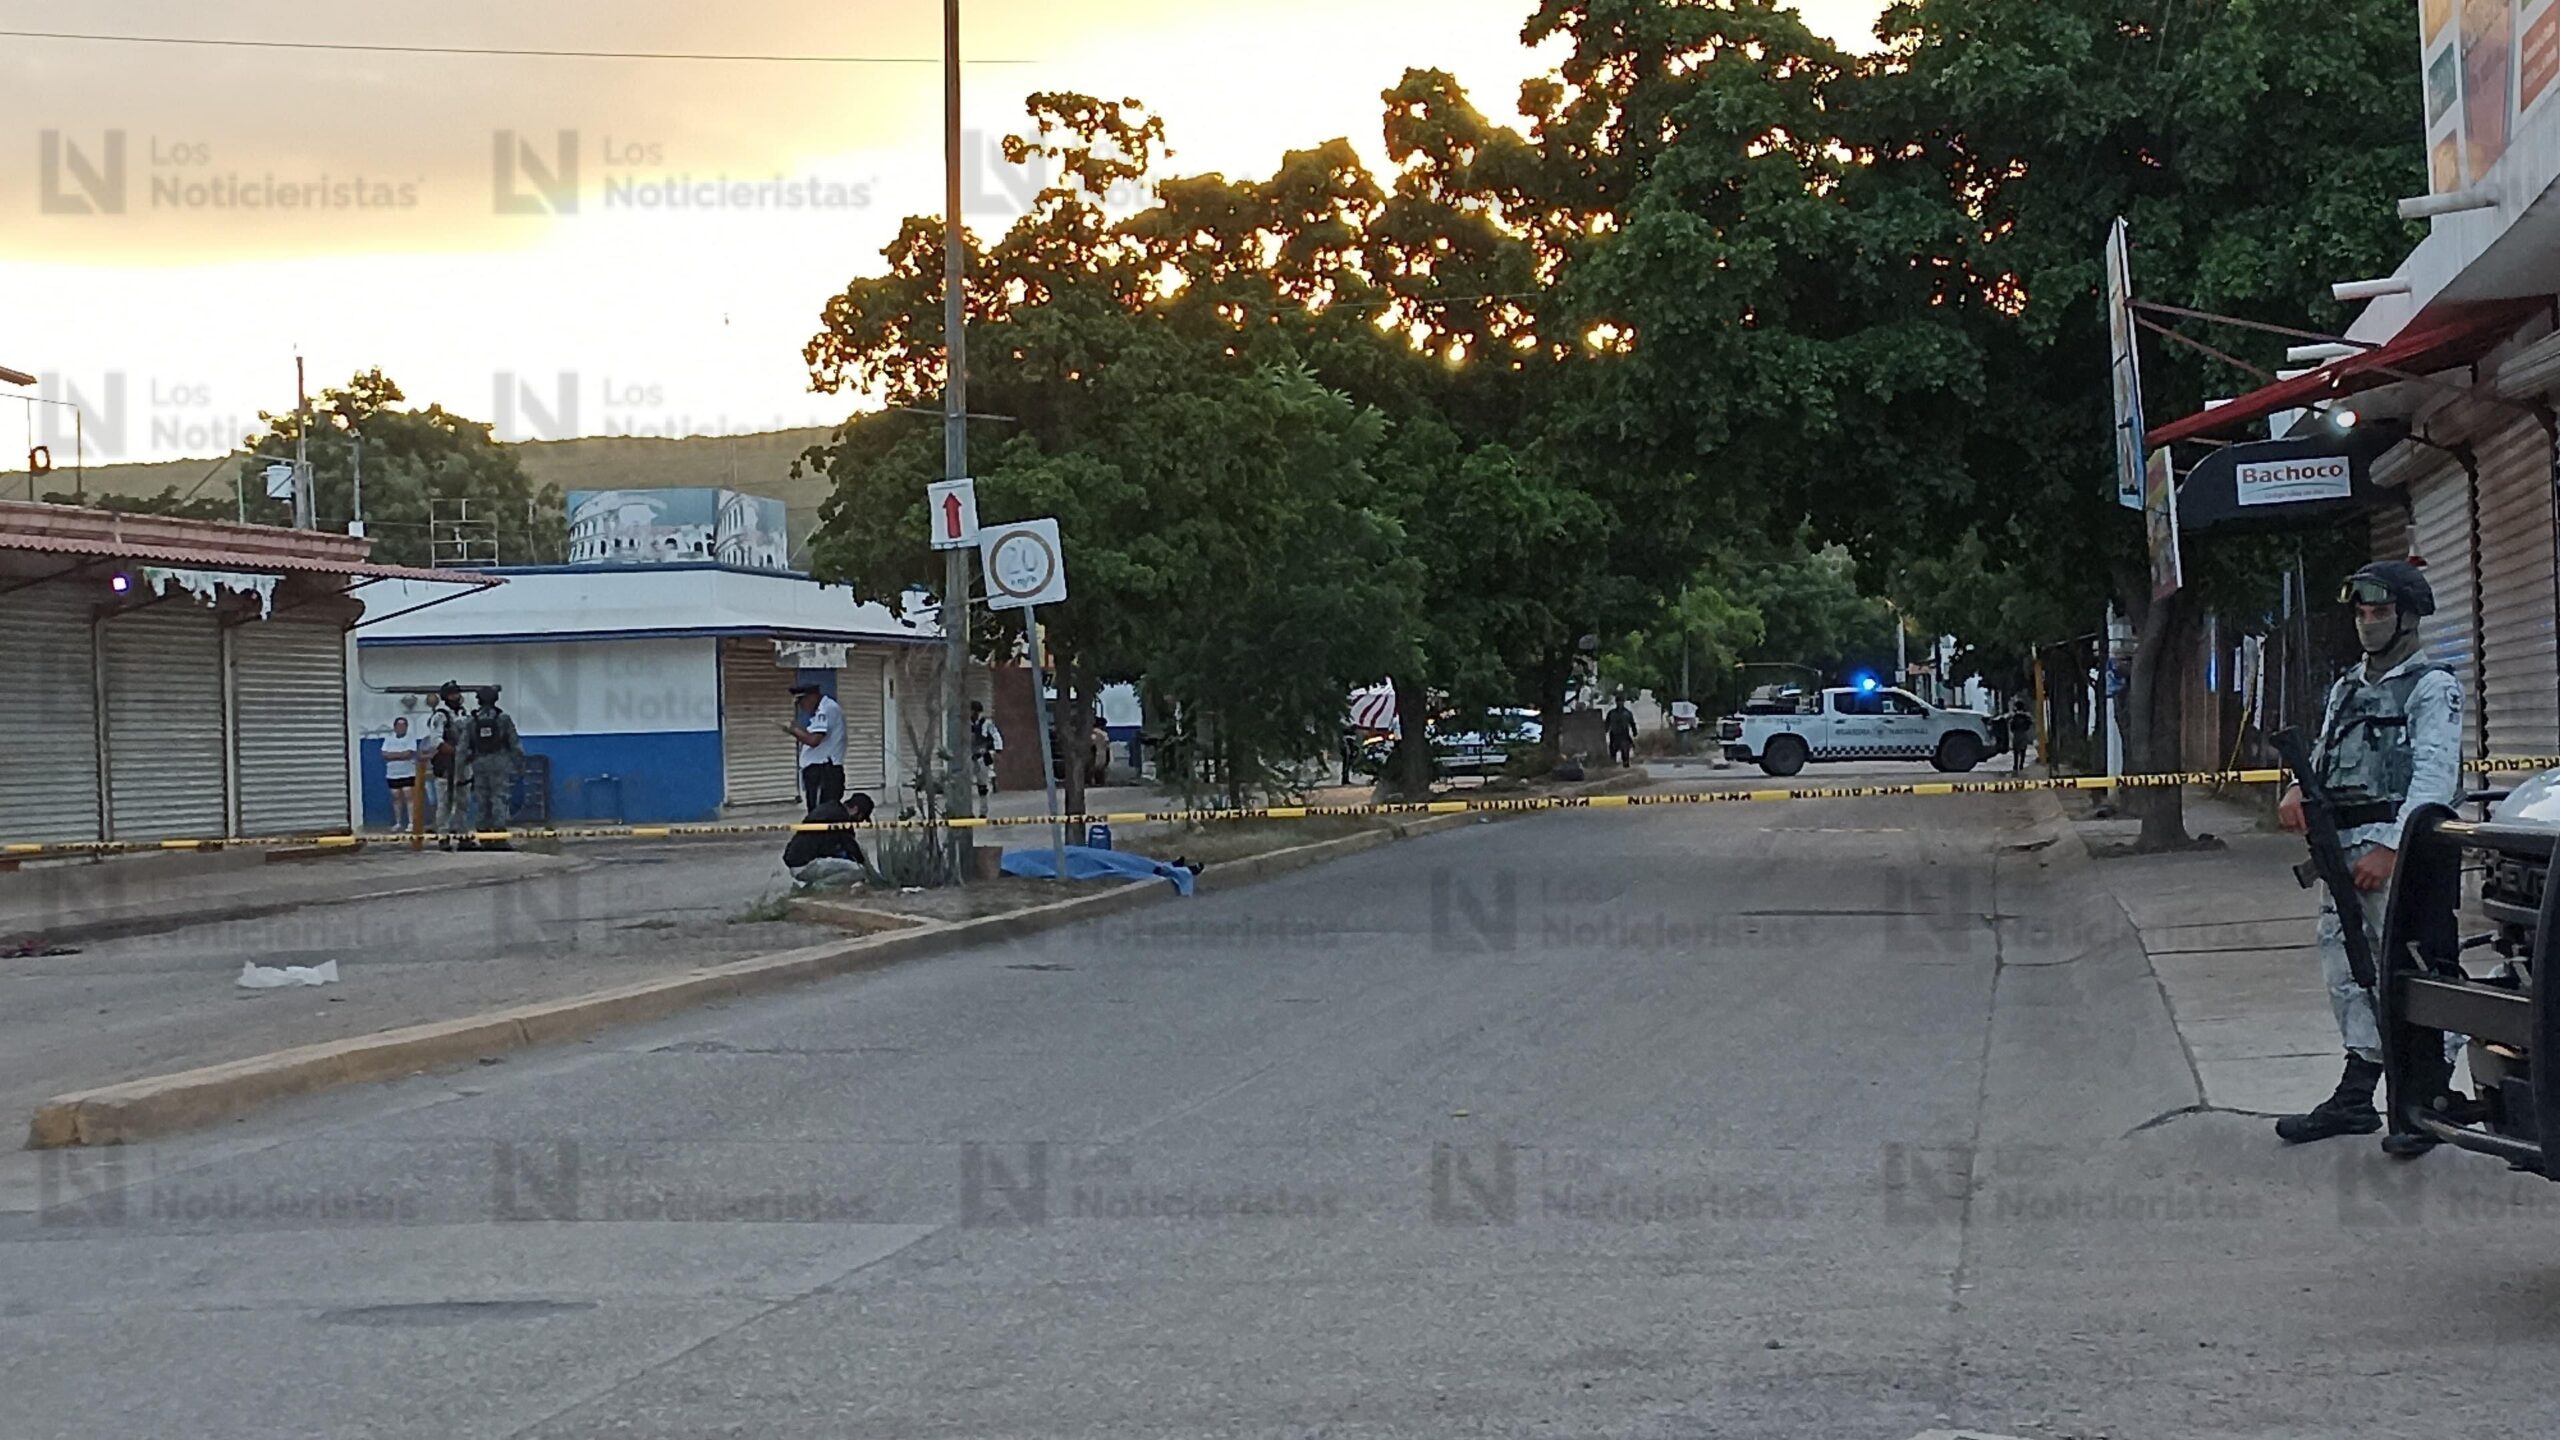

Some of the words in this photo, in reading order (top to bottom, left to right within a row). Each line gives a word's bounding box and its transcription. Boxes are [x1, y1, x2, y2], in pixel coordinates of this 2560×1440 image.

[2242, 464, 2343, 484] Bachoco
[1952, 779, 2076, 793] PRECAUCION
[2116, 772, 2241, 787] PRECAUCION
[1628, 792, 1751, 805] PRECAUCION
[1790, 785, 1913, 799] PRECAUCION
[1467, 797, 1590, 811] PRECAUCION
